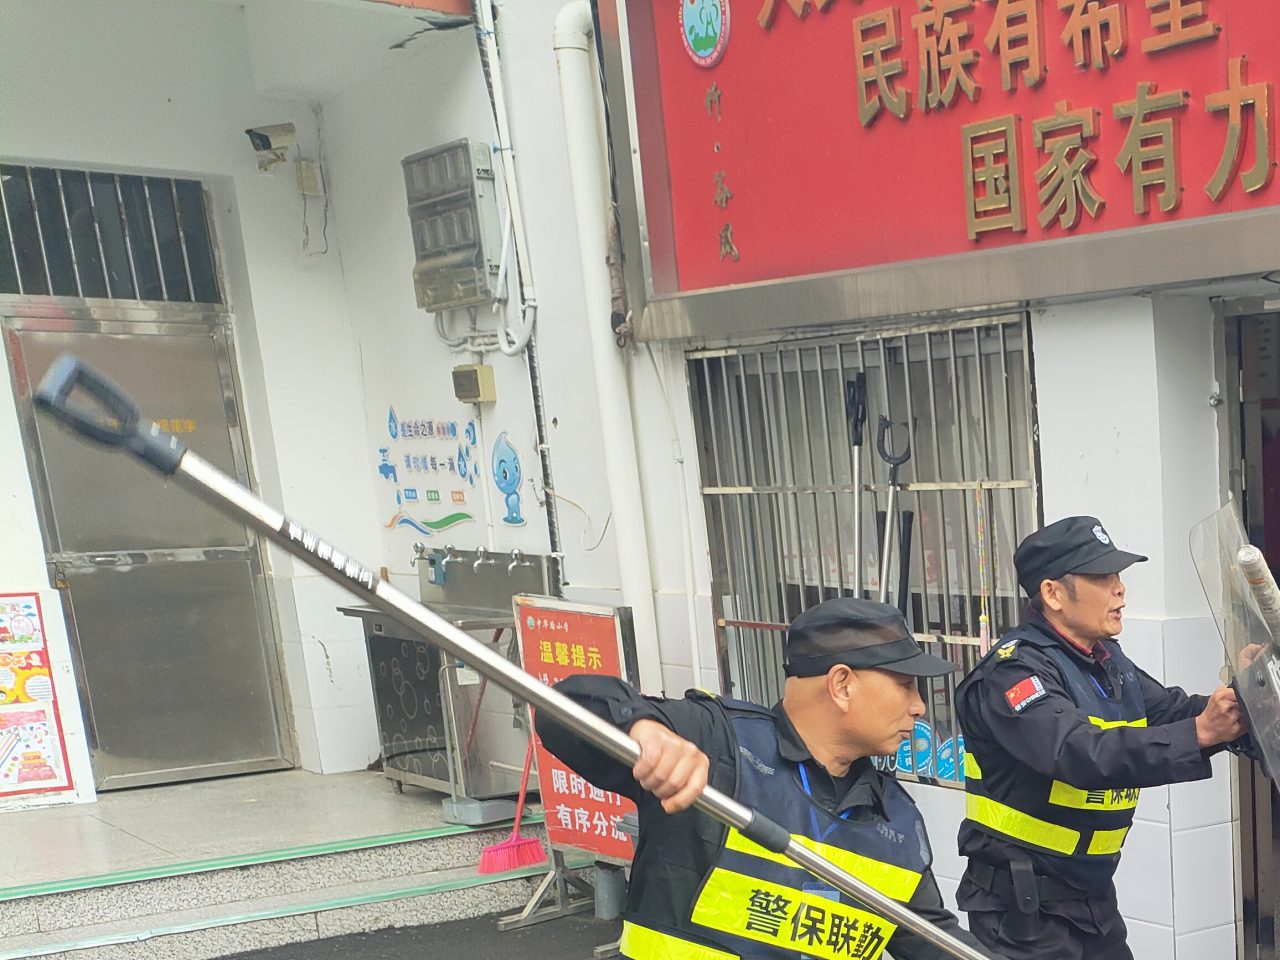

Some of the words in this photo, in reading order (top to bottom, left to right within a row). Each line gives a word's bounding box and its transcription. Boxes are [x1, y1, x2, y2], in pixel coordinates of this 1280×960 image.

[540, 640, 602, 670] 温馨提示
[556, 803, 628, 842] 有序分流
